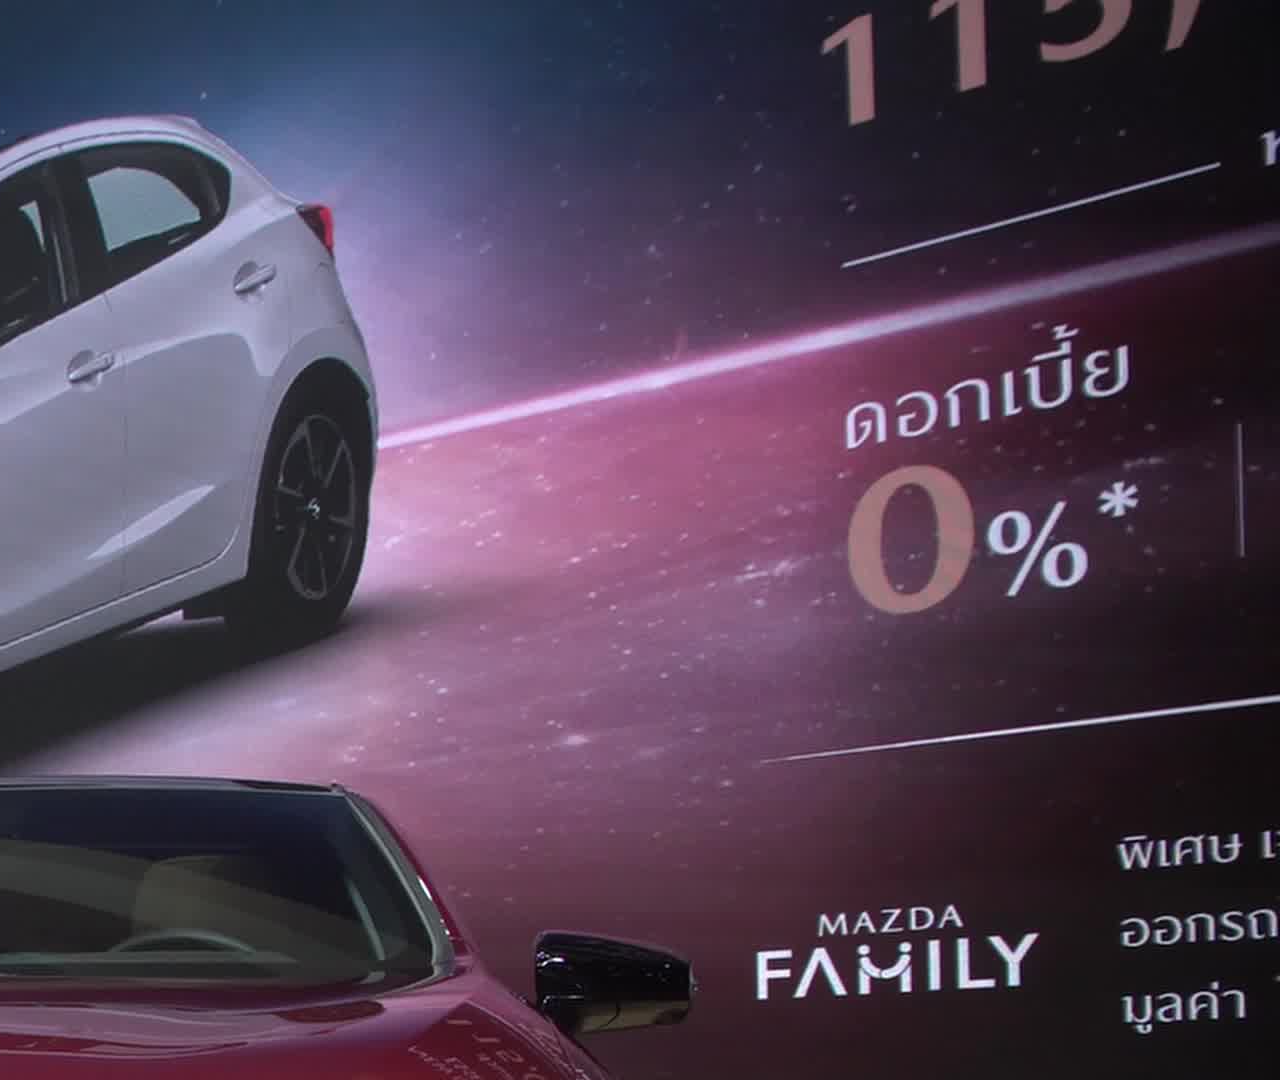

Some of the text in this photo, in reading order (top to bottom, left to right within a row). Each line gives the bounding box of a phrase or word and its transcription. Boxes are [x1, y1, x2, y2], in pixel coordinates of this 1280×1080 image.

[844, 324, 1130, 449] ดอกเบี้ย
[1117, 834, 1243, 870] พิเศษ
[817, 904, 964, 937] MAZDA
[755, 932, 1040, 1000] FAMILY
[1121, 980, 1247, 1034] มูลค่า
